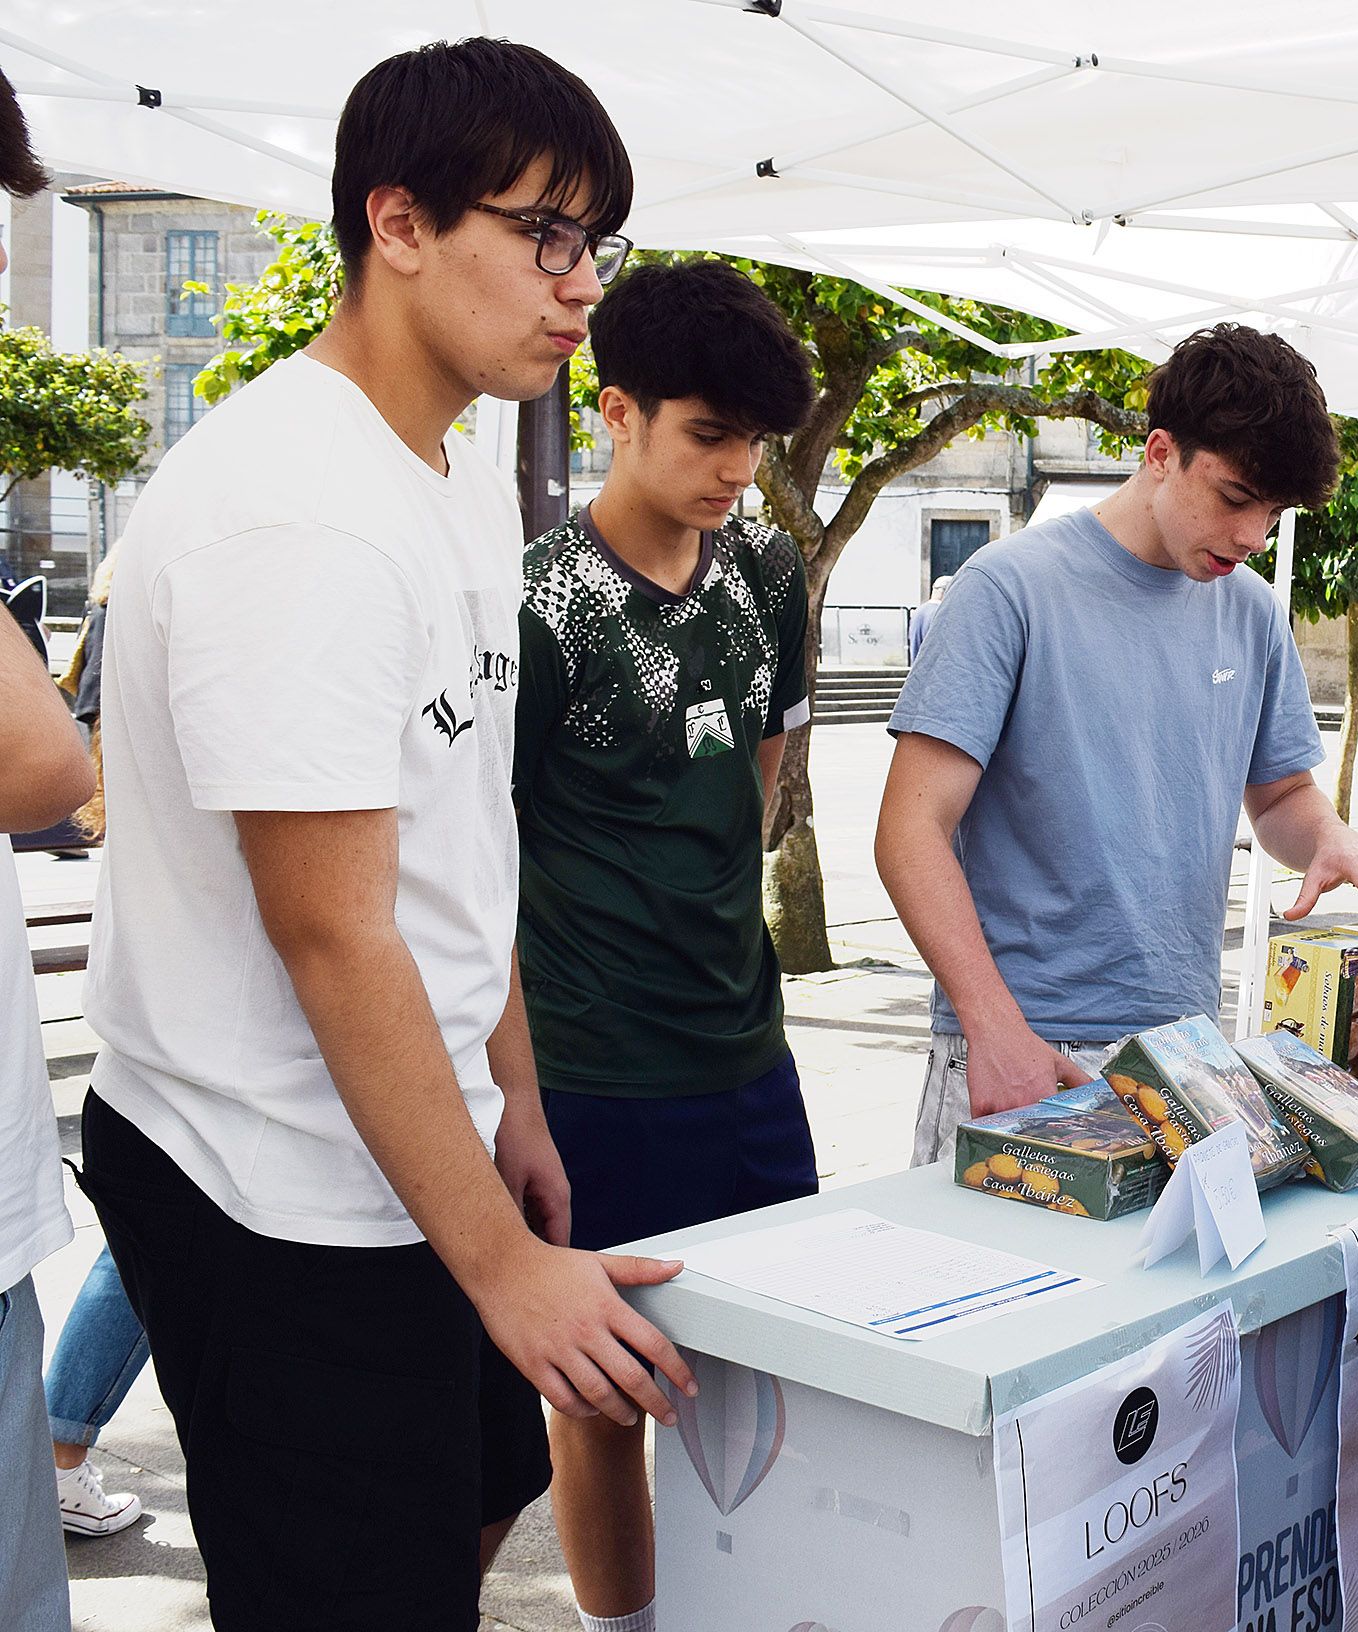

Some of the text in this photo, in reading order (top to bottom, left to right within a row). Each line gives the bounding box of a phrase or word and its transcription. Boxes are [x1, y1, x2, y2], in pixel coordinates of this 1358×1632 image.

[848, 633, 879, 647] Soy
[1123, 1094, 1150, 1126] Casa
[1160, 1087, 1203, 1141] Galletas
[1264, 1083, 1315, 1124] Galletas
[1163, 1106, 1193, 1149] Pasie
[1002, 1142, 1056, 1165] Galletas
[1014, 1158, 1075, 1182] Pasiegas
[982, 1176, 1076, 1208] Casa Ibáñez
[1085, 1462, 1188, 1560] LOOFS
[1060, 1565, 1136, 1630] COLECCIÓN
[1137, 1542, 1172, 1578] 2025
[1178, 1515, 1210, 1550] 2026
[1237, 1500, 1338, 1624] PRENDE
[1291, 1565, 1338, 1631] ESO
